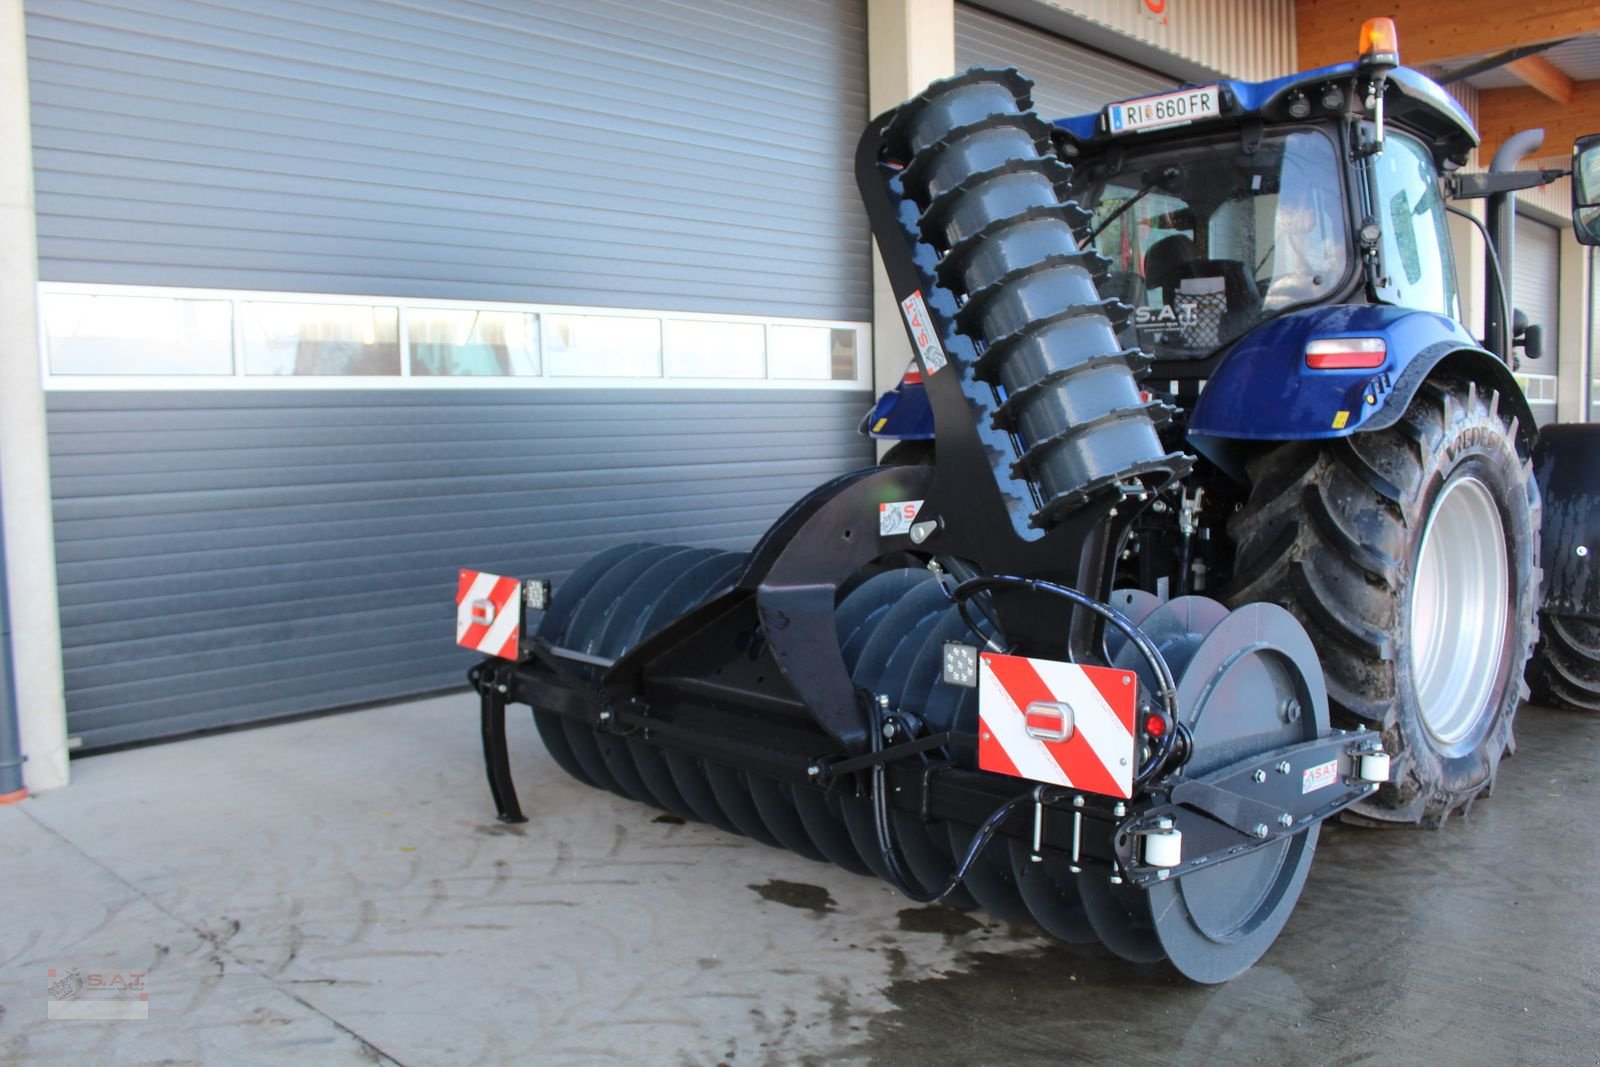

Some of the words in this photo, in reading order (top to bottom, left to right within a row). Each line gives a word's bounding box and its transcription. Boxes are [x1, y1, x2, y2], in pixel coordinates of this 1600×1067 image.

[1127, 105, 1143, 125] RI
[1155, 97, 1187, 120] 660
[1189, 93, 1211, 114] FR
